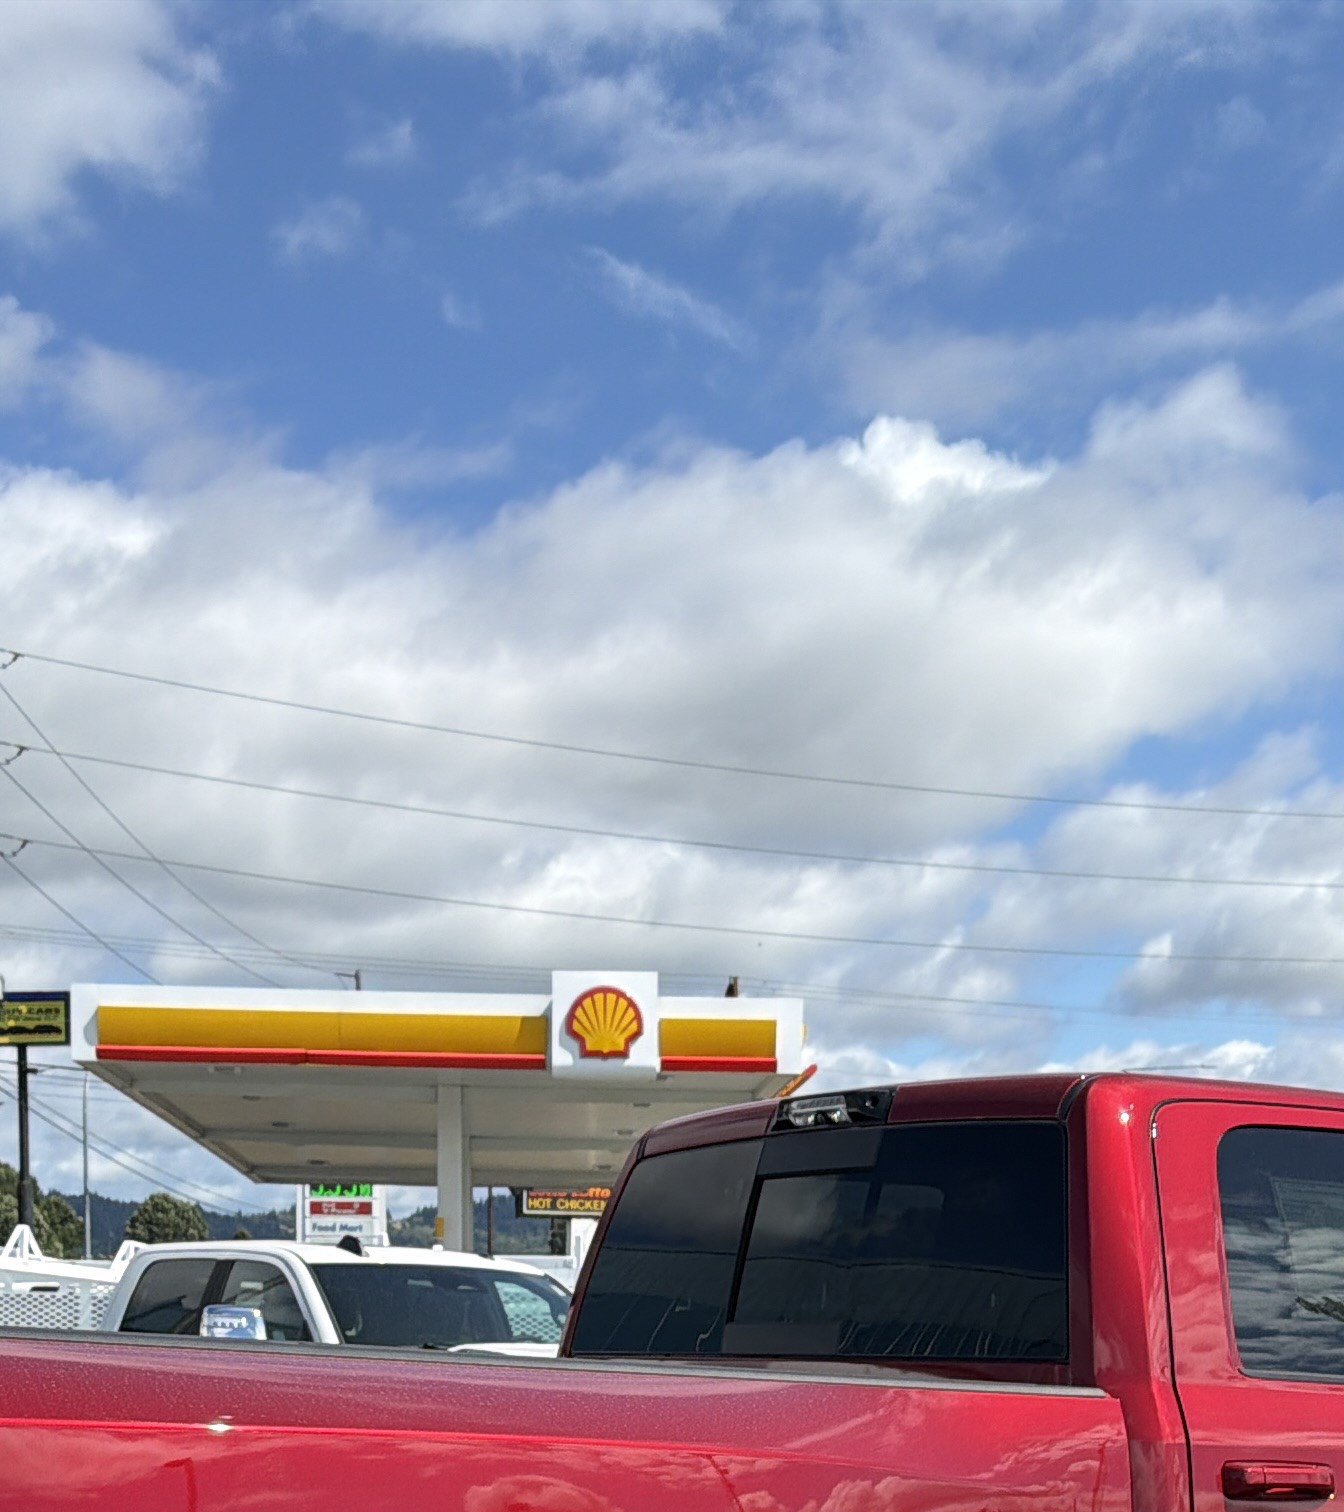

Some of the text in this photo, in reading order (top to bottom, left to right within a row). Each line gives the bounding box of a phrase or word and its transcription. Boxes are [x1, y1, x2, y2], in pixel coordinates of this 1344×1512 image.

[528, 1198, 553, 1209] HOT
[312, 1222, 363, 1232] Food Mart
